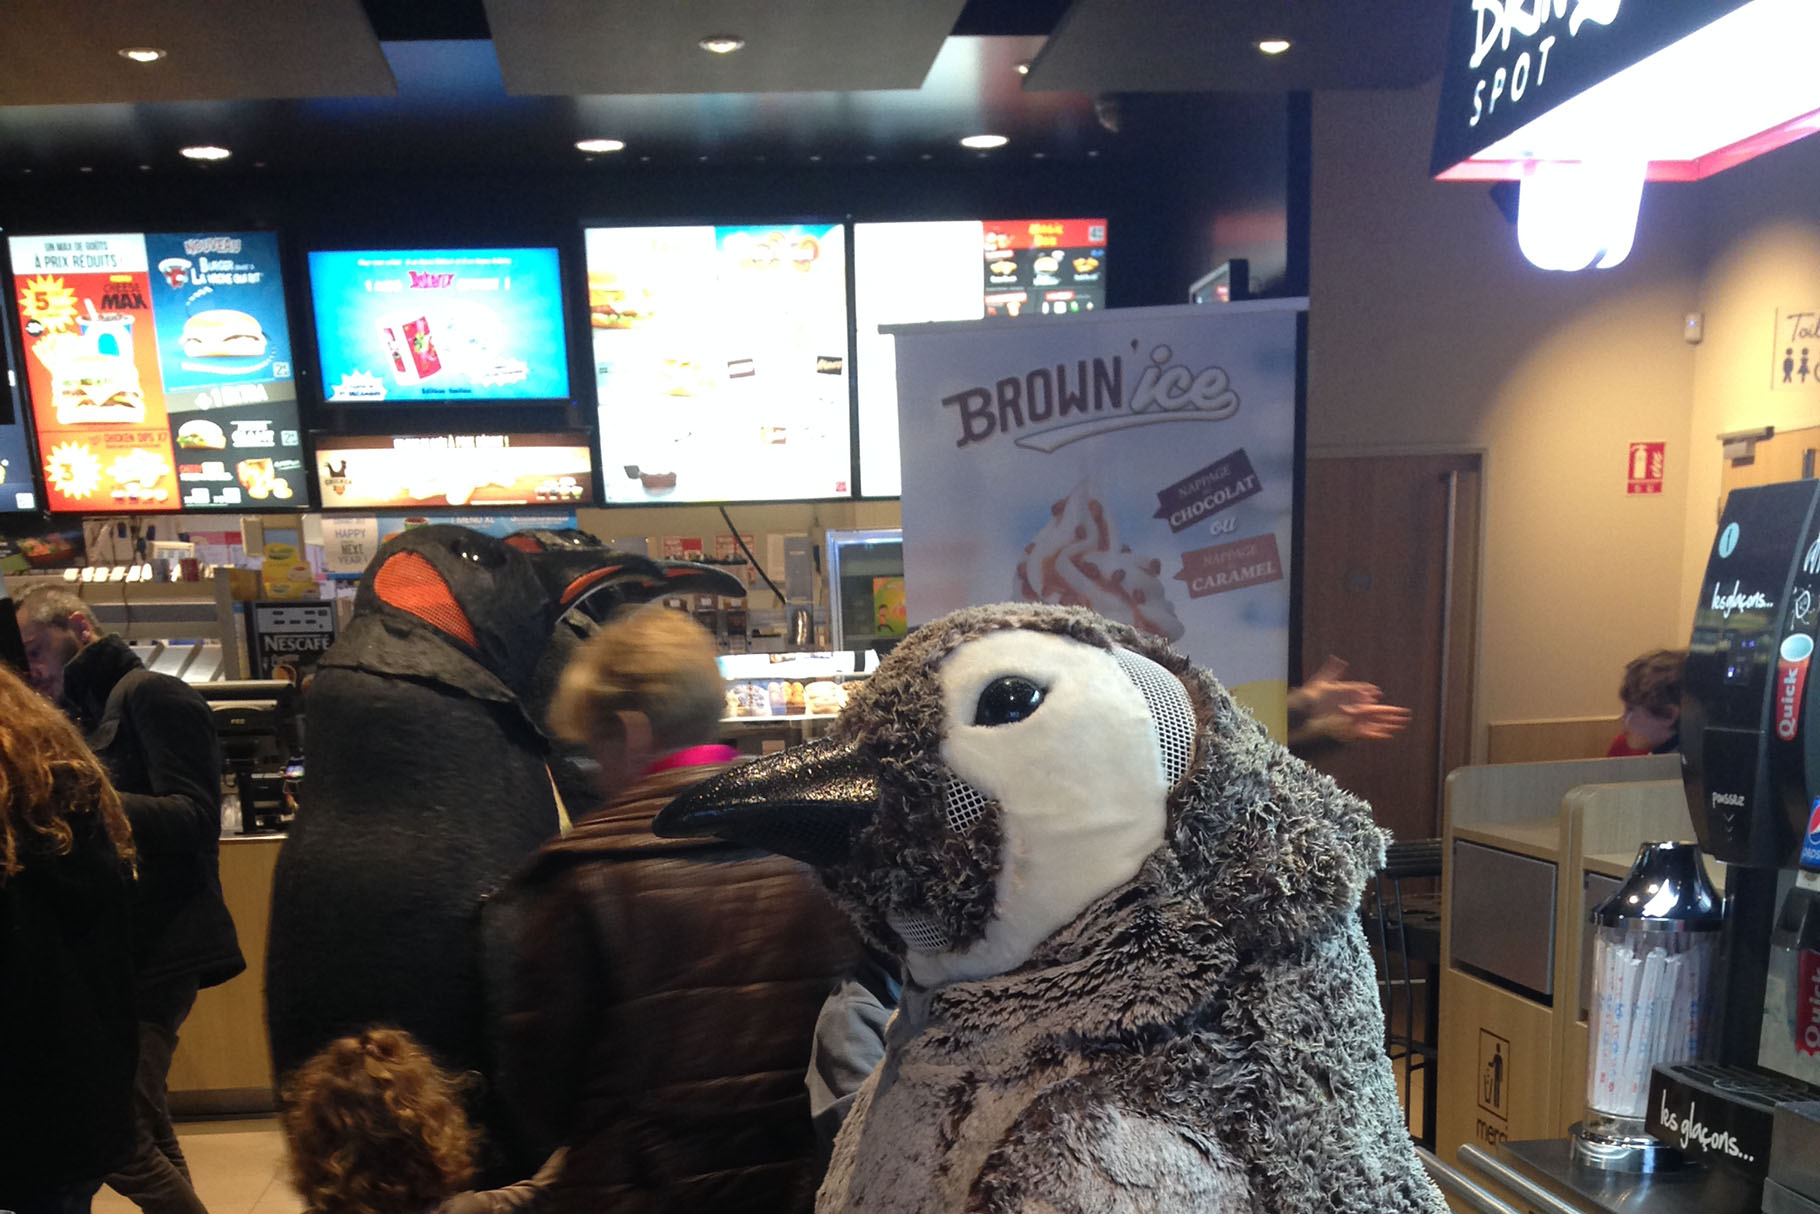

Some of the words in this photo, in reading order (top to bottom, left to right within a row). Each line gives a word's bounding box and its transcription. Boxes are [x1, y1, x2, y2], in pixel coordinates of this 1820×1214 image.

[1469, 35, 1556, 127] SPOT
[44, 255, 68, 268] PRIX
[73, 253, 117, 268] RÉDUITS
[34, 291, 50, 310] 5
[101, 293, 148, 310] MAX
[1170, 474, 1256, 527] CHOCOLAT
[335, 529, 366, 538] HAPPY
[1209, 517, 1239, 536] ou
[1192, 561, 1276, 592] CARAMEL
[1778, 667, 1799, 738] Quick
[1660, 1089, 1679, 1131] les
